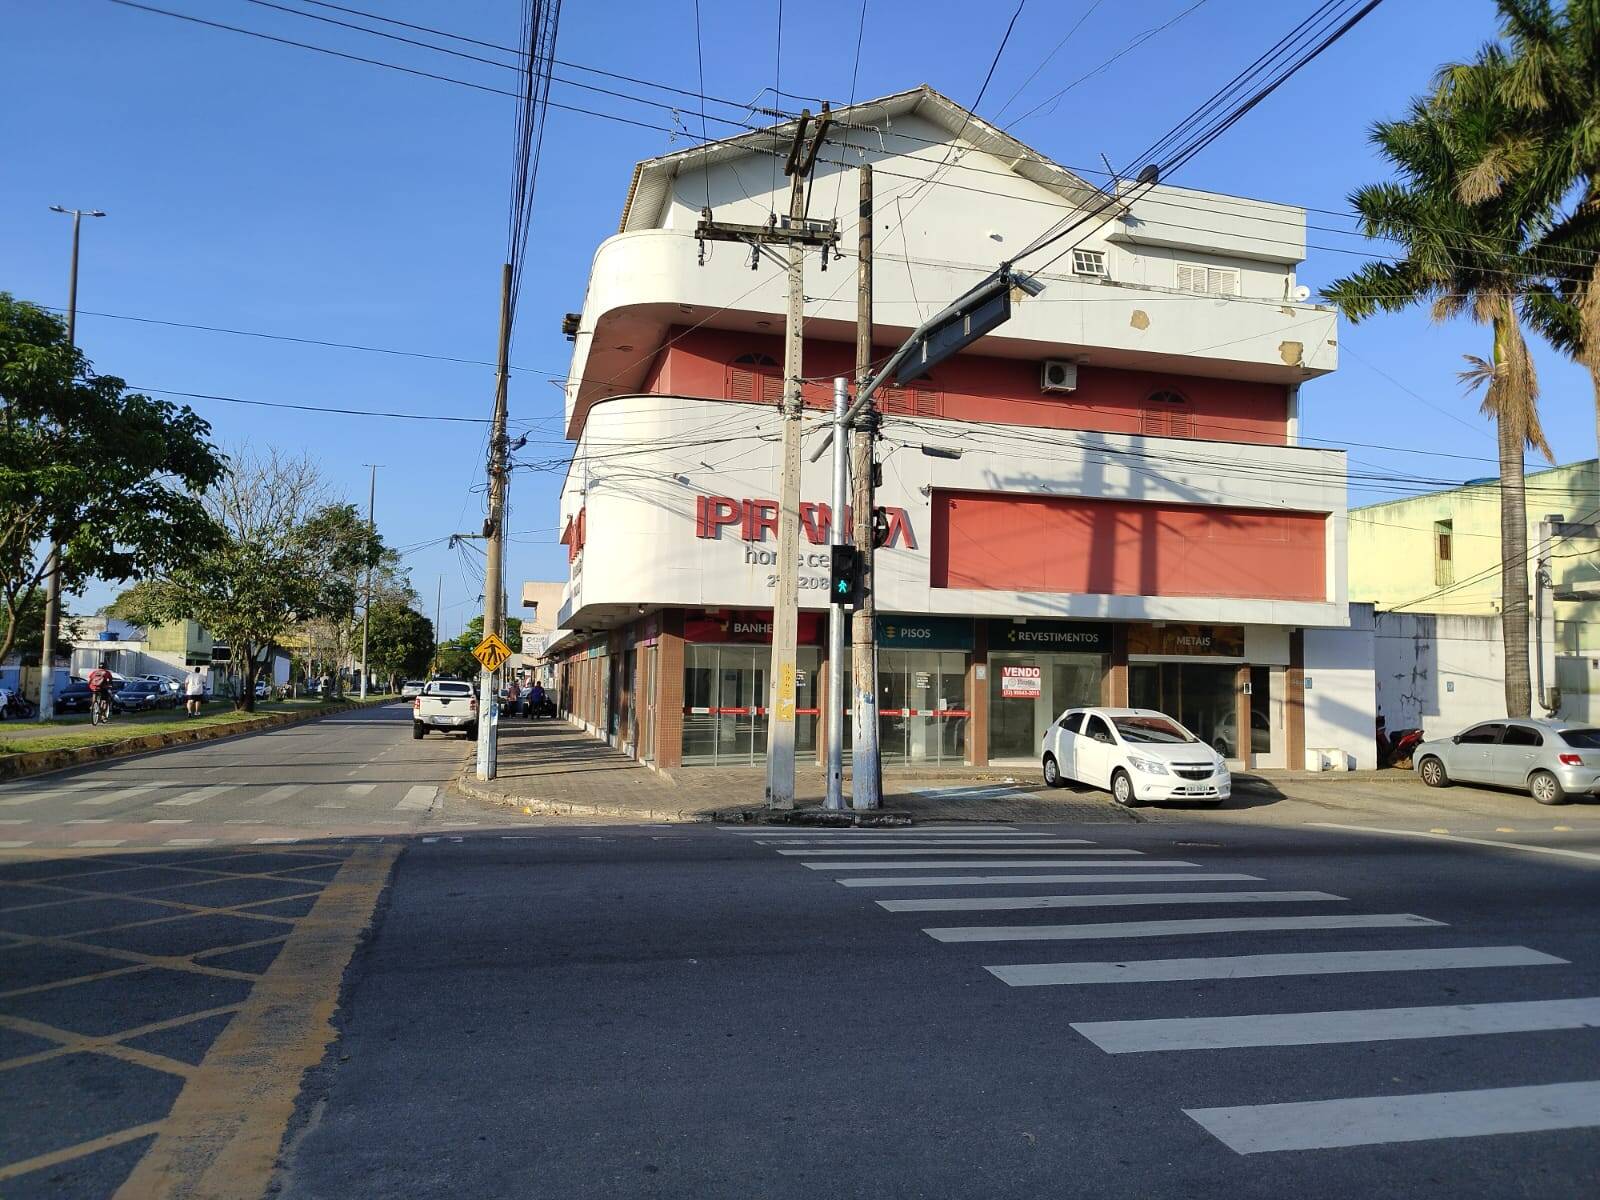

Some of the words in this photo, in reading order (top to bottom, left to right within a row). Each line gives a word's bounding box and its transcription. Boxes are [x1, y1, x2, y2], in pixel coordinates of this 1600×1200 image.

[695, 495, 917, 549] IPIRANA
[901, 628, 932, 639] PISOS
[1018, 631, 1099, 643] REVESTIMENTOS
[1176, 636, 1211, 647] METAIS
[1003, 667, 1040, 677] VENDO
